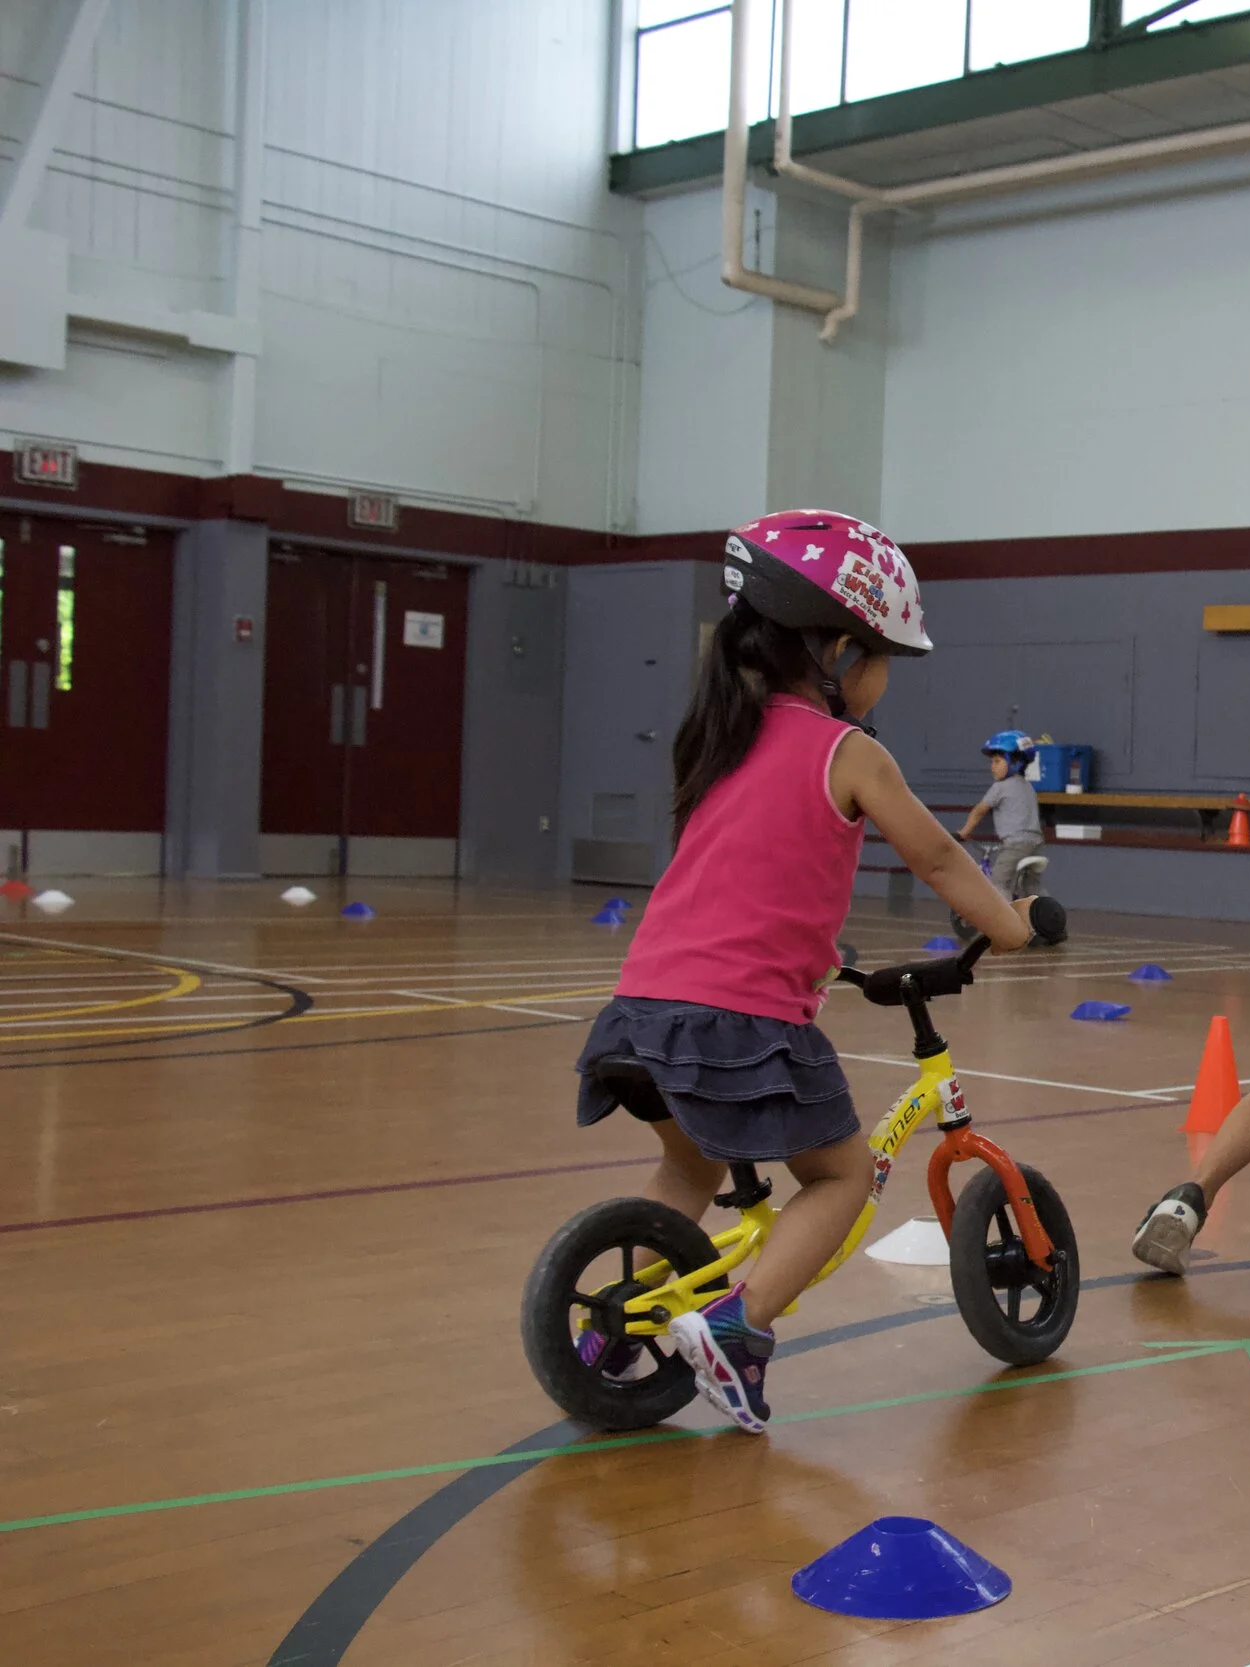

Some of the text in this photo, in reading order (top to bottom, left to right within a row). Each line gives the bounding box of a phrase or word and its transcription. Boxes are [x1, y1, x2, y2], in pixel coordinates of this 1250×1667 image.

[29, 447, 71, 480] EXIT
[844, 572, 890, 618] Wheels
[868, 584, 885, 602] on
